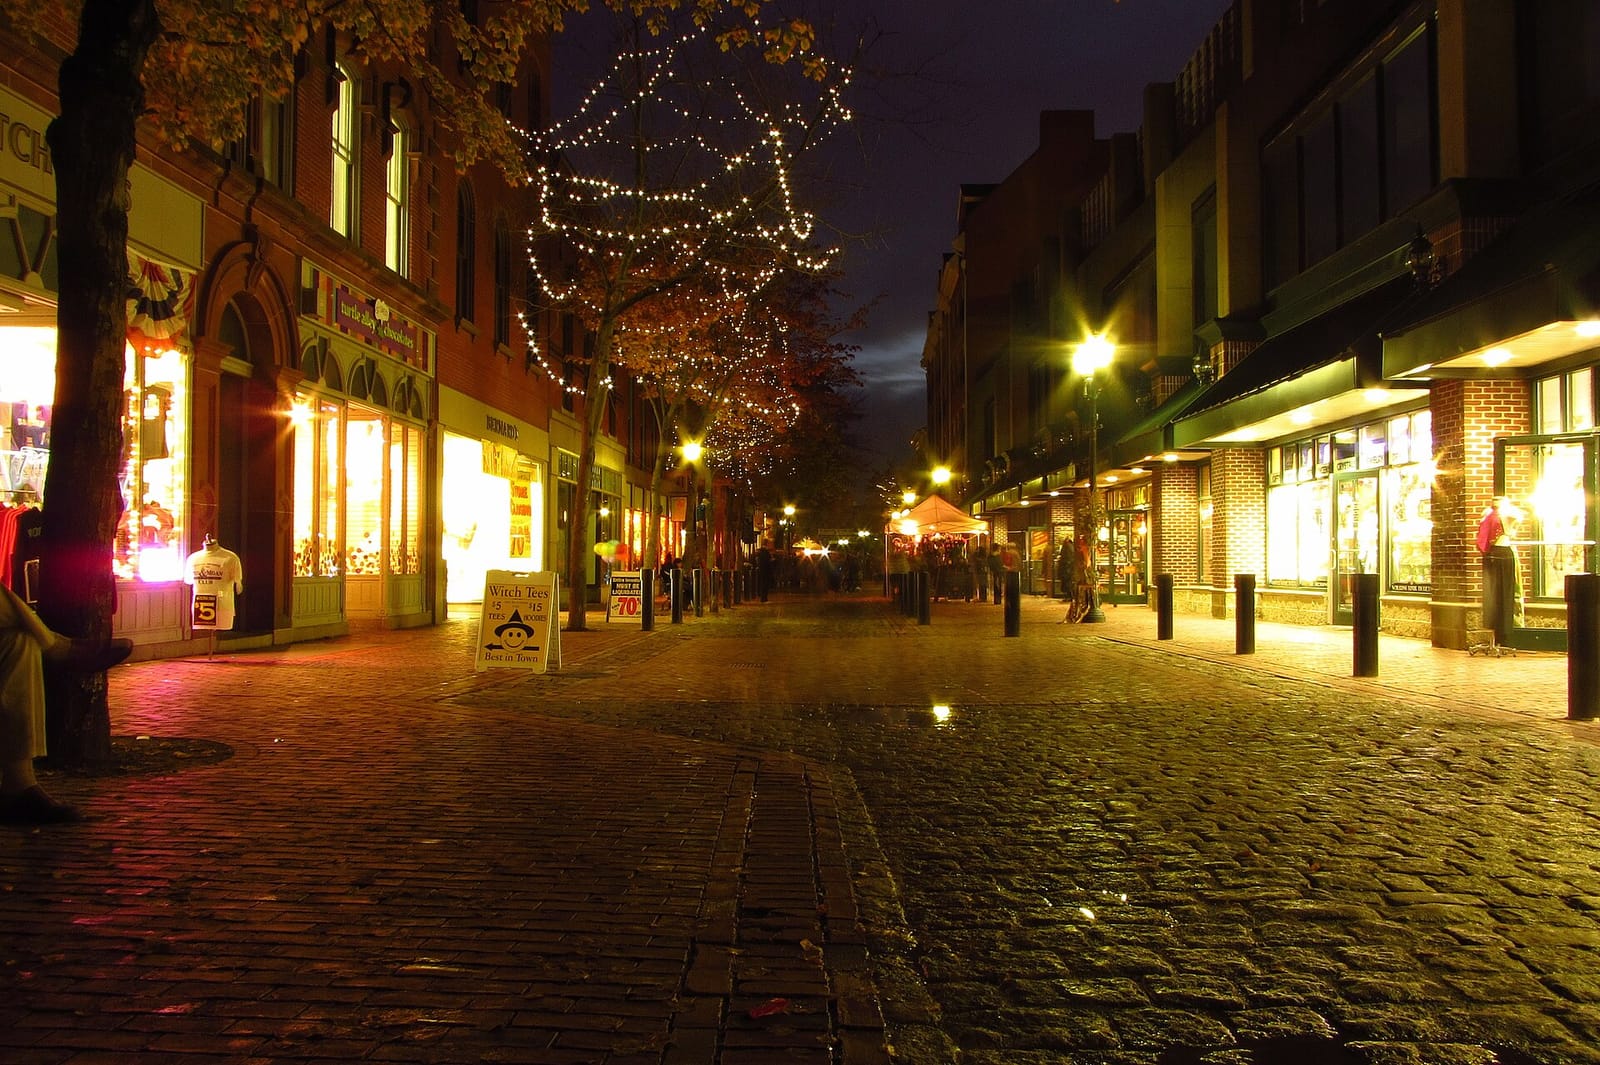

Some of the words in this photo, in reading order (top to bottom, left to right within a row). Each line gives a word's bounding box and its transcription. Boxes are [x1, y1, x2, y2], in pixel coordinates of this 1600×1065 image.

[341, 300, 361, 322] turtle
[361, 310, 377, 334] alley
[383, 322, 414, 349] chocolates
[489, 585, 522, 598] Witch
[526, 586, 549, 599] Tees
[195, 601, 216, 621] $5
[492, 601, 502, 610] $5
[529, 602, 542, 612] $15
[524, 614, 547, 622] HOODIES
[485, 652, 502, 661] Best
[505, 652, 513, 661] in
[516, 653, 538, 662] Town
